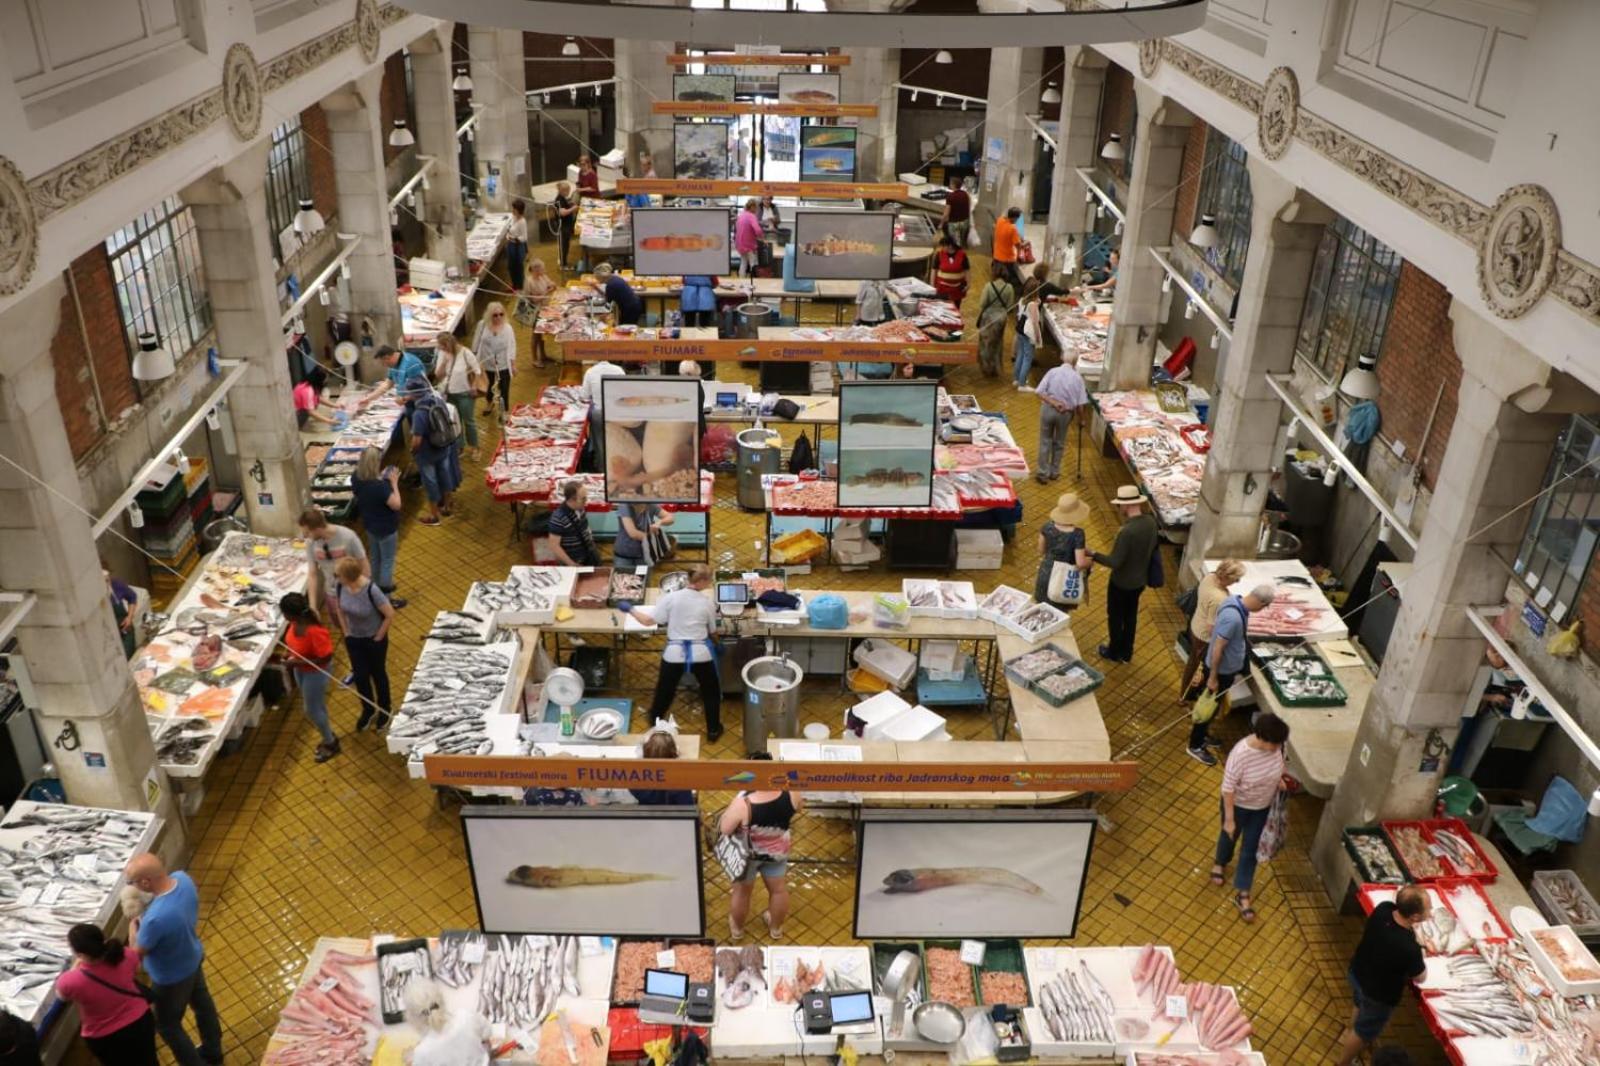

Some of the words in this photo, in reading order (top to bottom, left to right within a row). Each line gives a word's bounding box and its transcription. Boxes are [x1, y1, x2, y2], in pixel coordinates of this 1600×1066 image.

[652, 345, 705, 355] FIUMARE
[499, 769, 538, 780] festival
[540, 772, 567, 780] mora
[576, 767, 666, 783] FIUMARE
[879, 772, 904, 783] riba
[905, 772, 974, 785] Jadranskog
